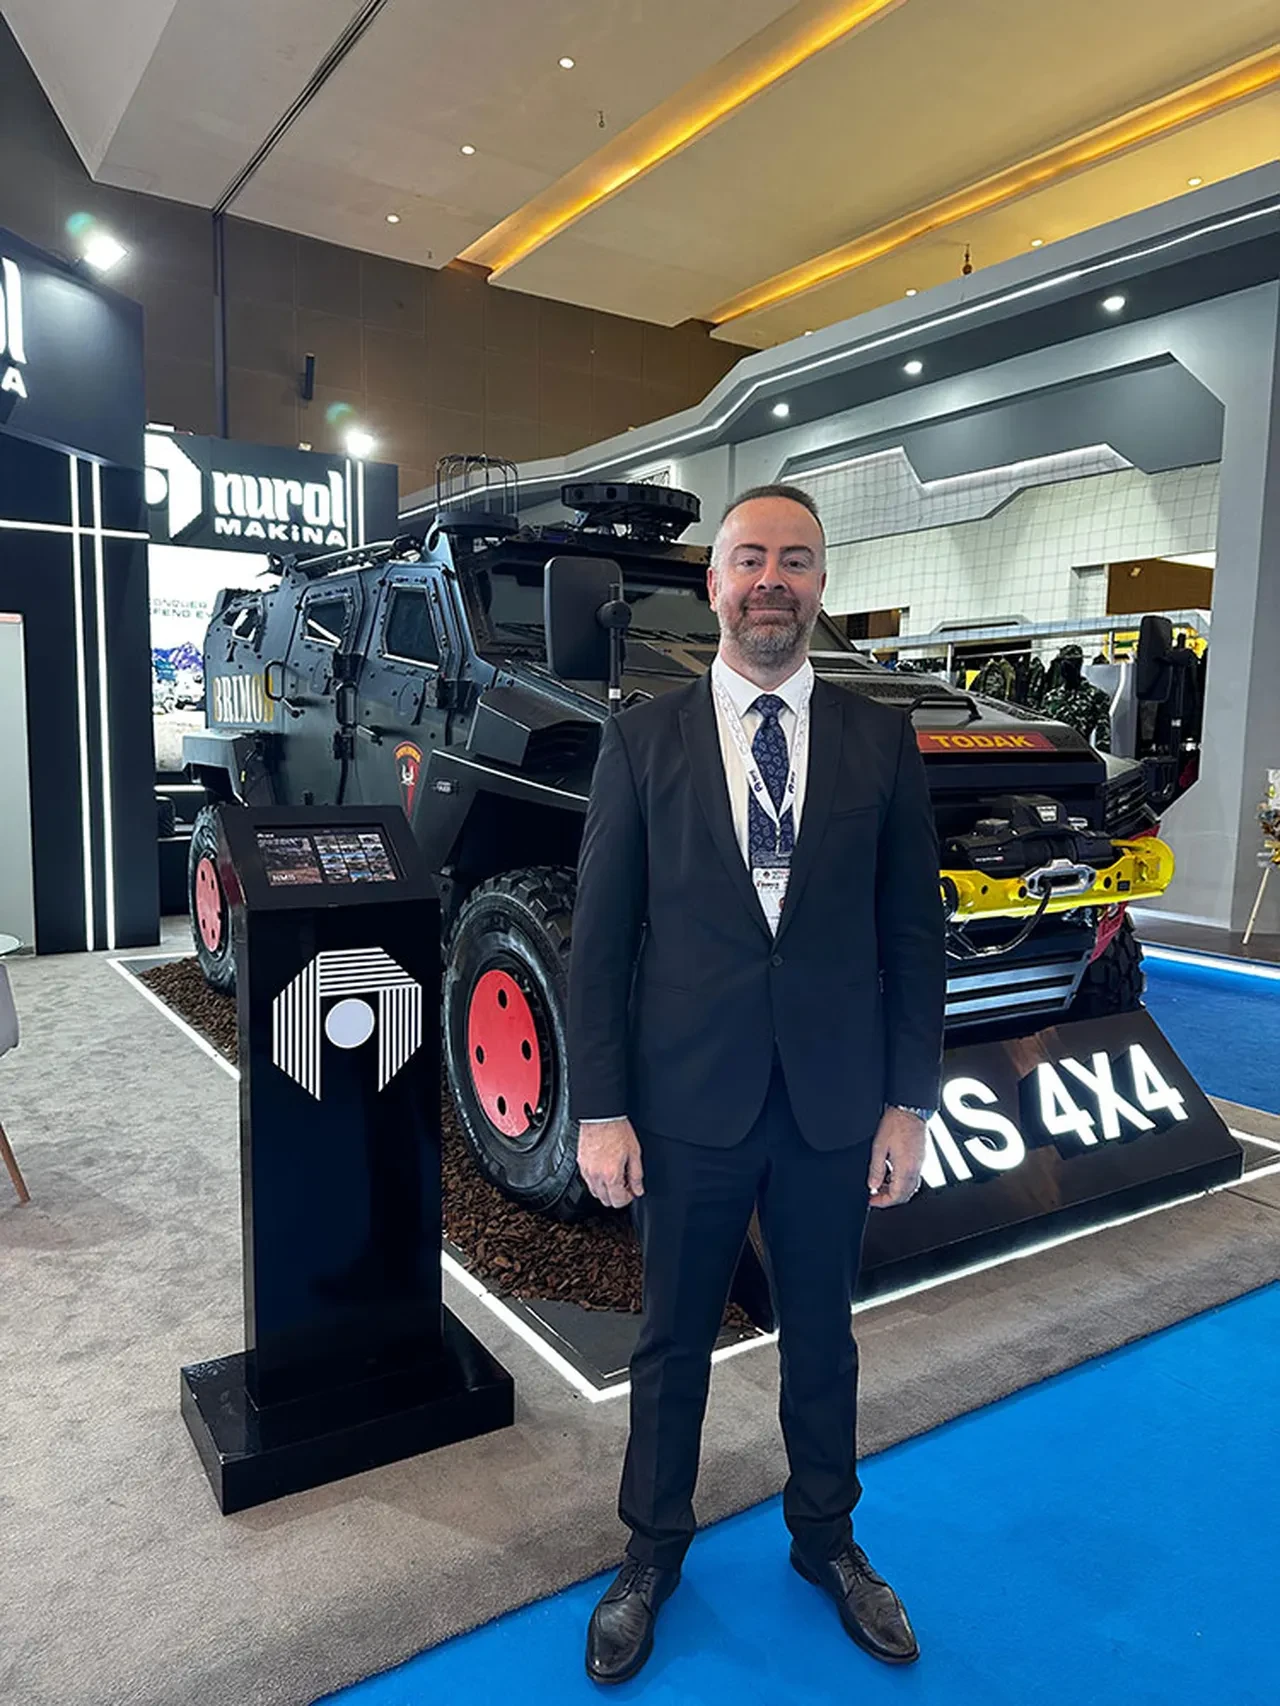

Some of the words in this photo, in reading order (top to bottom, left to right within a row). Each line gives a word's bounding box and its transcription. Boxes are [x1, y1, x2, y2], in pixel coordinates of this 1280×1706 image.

[211, 470, 346, 528] nurol
[928, 735, 1035, 748] TODAK
[1036, 1043, 1189, 1146] 4X4
